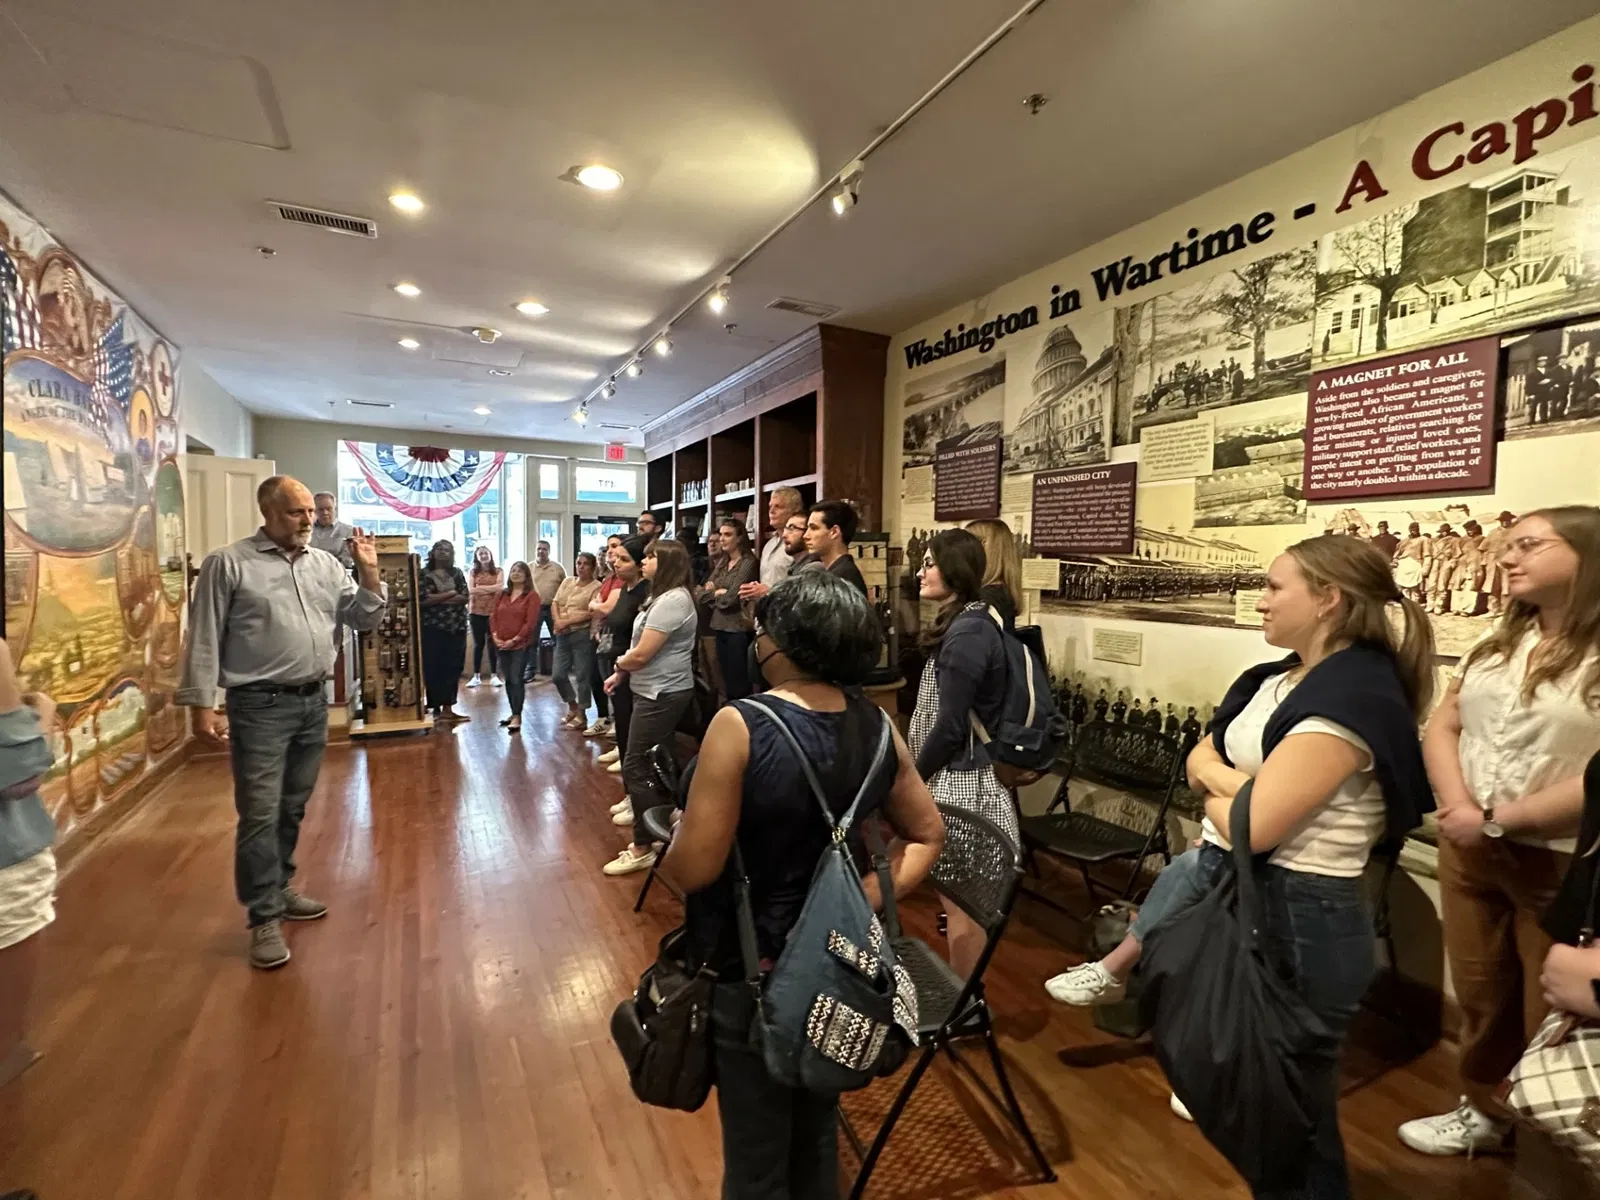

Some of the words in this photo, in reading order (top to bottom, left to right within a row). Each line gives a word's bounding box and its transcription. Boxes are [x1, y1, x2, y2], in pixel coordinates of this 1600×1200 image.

[904, 303, 1039, 369] Washington
[1049, 285, 1082, 319] in
[1091, 211, 1275, 302] Wartime
[1335, 160, 1389, 214] A
[1411, 64, 1600, 181] Capi
[1317, 380, 1328, 391] A
[1331, 366, 1395, 388] MAGNET
[1398, 359, 1432, 375] FOR
[1435, 352, 1469, 368] ALL
[28, 379, 71, 402] CLARA
[1315, 395, 1337, 404] Aside
[1339, 392, 1359, 400] from
[1361, 388, 1374, 396] the
[1376, 383, 1410, 393] soldiers
[1412, 376, 1429, 387] and
[1432, 369, 1485, 383] caregivers,
[1315, 401, 1360, 413] Washington
[1384, 391, 1417, 402] became
[1430, 383, 1465, 394] magnet
[1470, 379, 1485, 388] for
[1313, 423, 1345, 434] growing
[1346, 418, 1377, 428] number
[1378, 414, 1389, 423] of
[1389, 408, 1442, 423] government
[1444, 403, 1483, 413] workers
[1314, 408, 1363, 423] newly-freed
[1370, 404, 1404, 414] African
[1412, 395, 1469, 408] Americans,
[1313, 433, 1326, 442] and
[1329, 429, 1376, 440] bureaucrats,
[1380, 423, 1416, 433] relatives
[1419, 416, 1464, 428] searching
[1468, 412, 1483, 421] for
[1313, 442, 1330, 452] their
[1335, 440, 1366, 449] missing
[1386, 432, 1417, 443] injured
[1423, 427, 1449, 438] loved
[1456, 425, 1482, 434] ones,
[971, 444, 996, 455] SOLDIERS
[1311, 461, 1337, 472] people
[1339, 460, 1362, 468] intent
[1379, 453, 1417, 465] profiting
[1421, 451, 1444, 459] from
[1470, 446, 1480, 454] in
[1312, 453, 1341, 461] military
[1342, 449, 1372, 458] support
[1374, 444, 1394, 454] staff,
[1396, 441, 1421, 451] relief
[1421, 439, 1461, 448] workers,
[1463, 434, 1481, 444] and
[1048, 473, 1090, 484] UNFINISHED
[1092, 470, 1111, 479] CITY
[1323, 481, 1337, 489] city
[1338, 479, 1362, 487] nearly
[1363, 475, 1397, 485] doubled
[1399, 473, 1427, 481] within
[1435, 469, 1471, 479] decade.
[1358, 467, 1391, 476] another.
[1395, 464, 1412, 472] The
[1415, 459, 1465, 472] population
[1469, 456, 1482, 465] of
